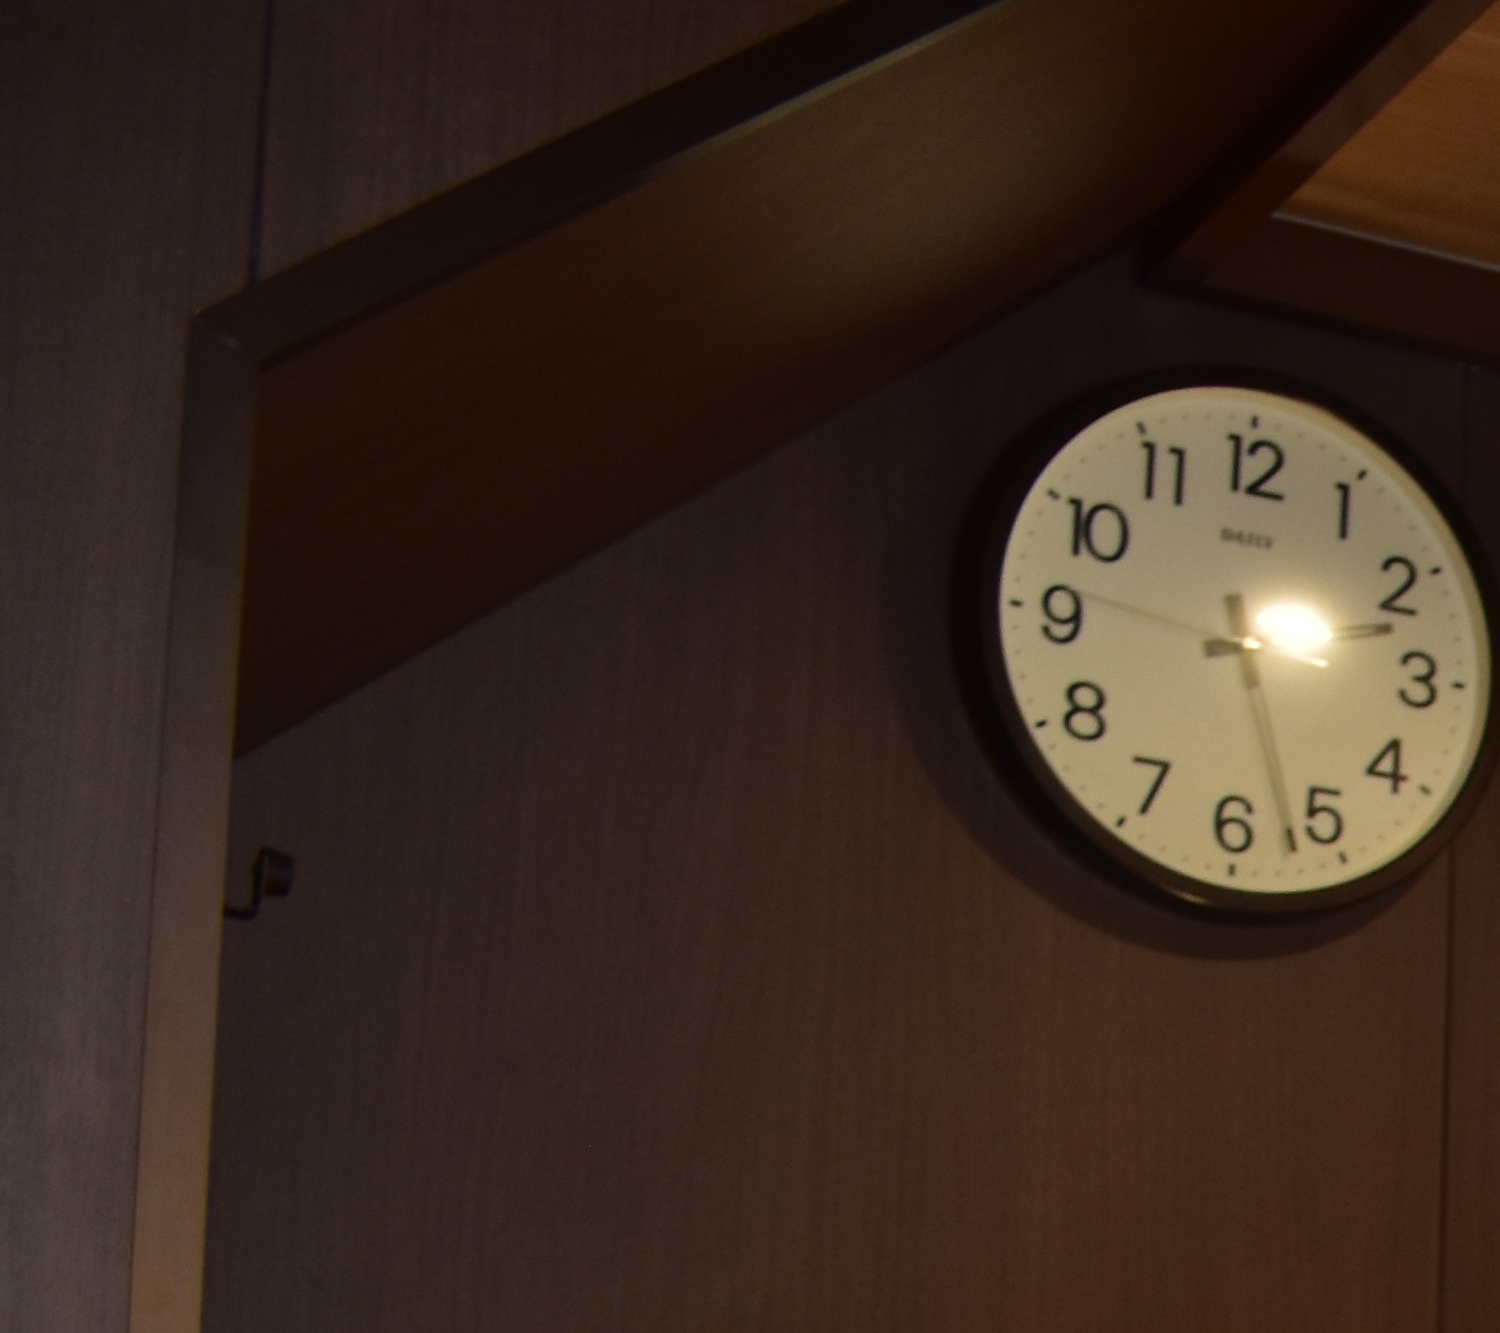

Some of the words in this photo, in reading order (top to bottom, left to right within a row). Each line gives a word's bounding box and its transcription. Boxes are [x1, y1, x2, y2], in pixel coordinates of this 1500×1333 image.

[1141, 441, 1185, 506] 11
[1228, 433, 1284, 501] 12
[1068, 497, 1130, 563] 10
[1335, 481, 1350, 540] 1
[1041, 584, 1082, 644] 9
[1378, 555, 1418, 616] 2
[1398, 651, 1437, 709] 3
[1062, 681, 1107, 741] 8
[1133, 755, 1171, 815] 7
[1365, 737, 1408, 794] 4
[1213, 795, 1254, 853] 6
[1305, 786, 1343, 844] 5
